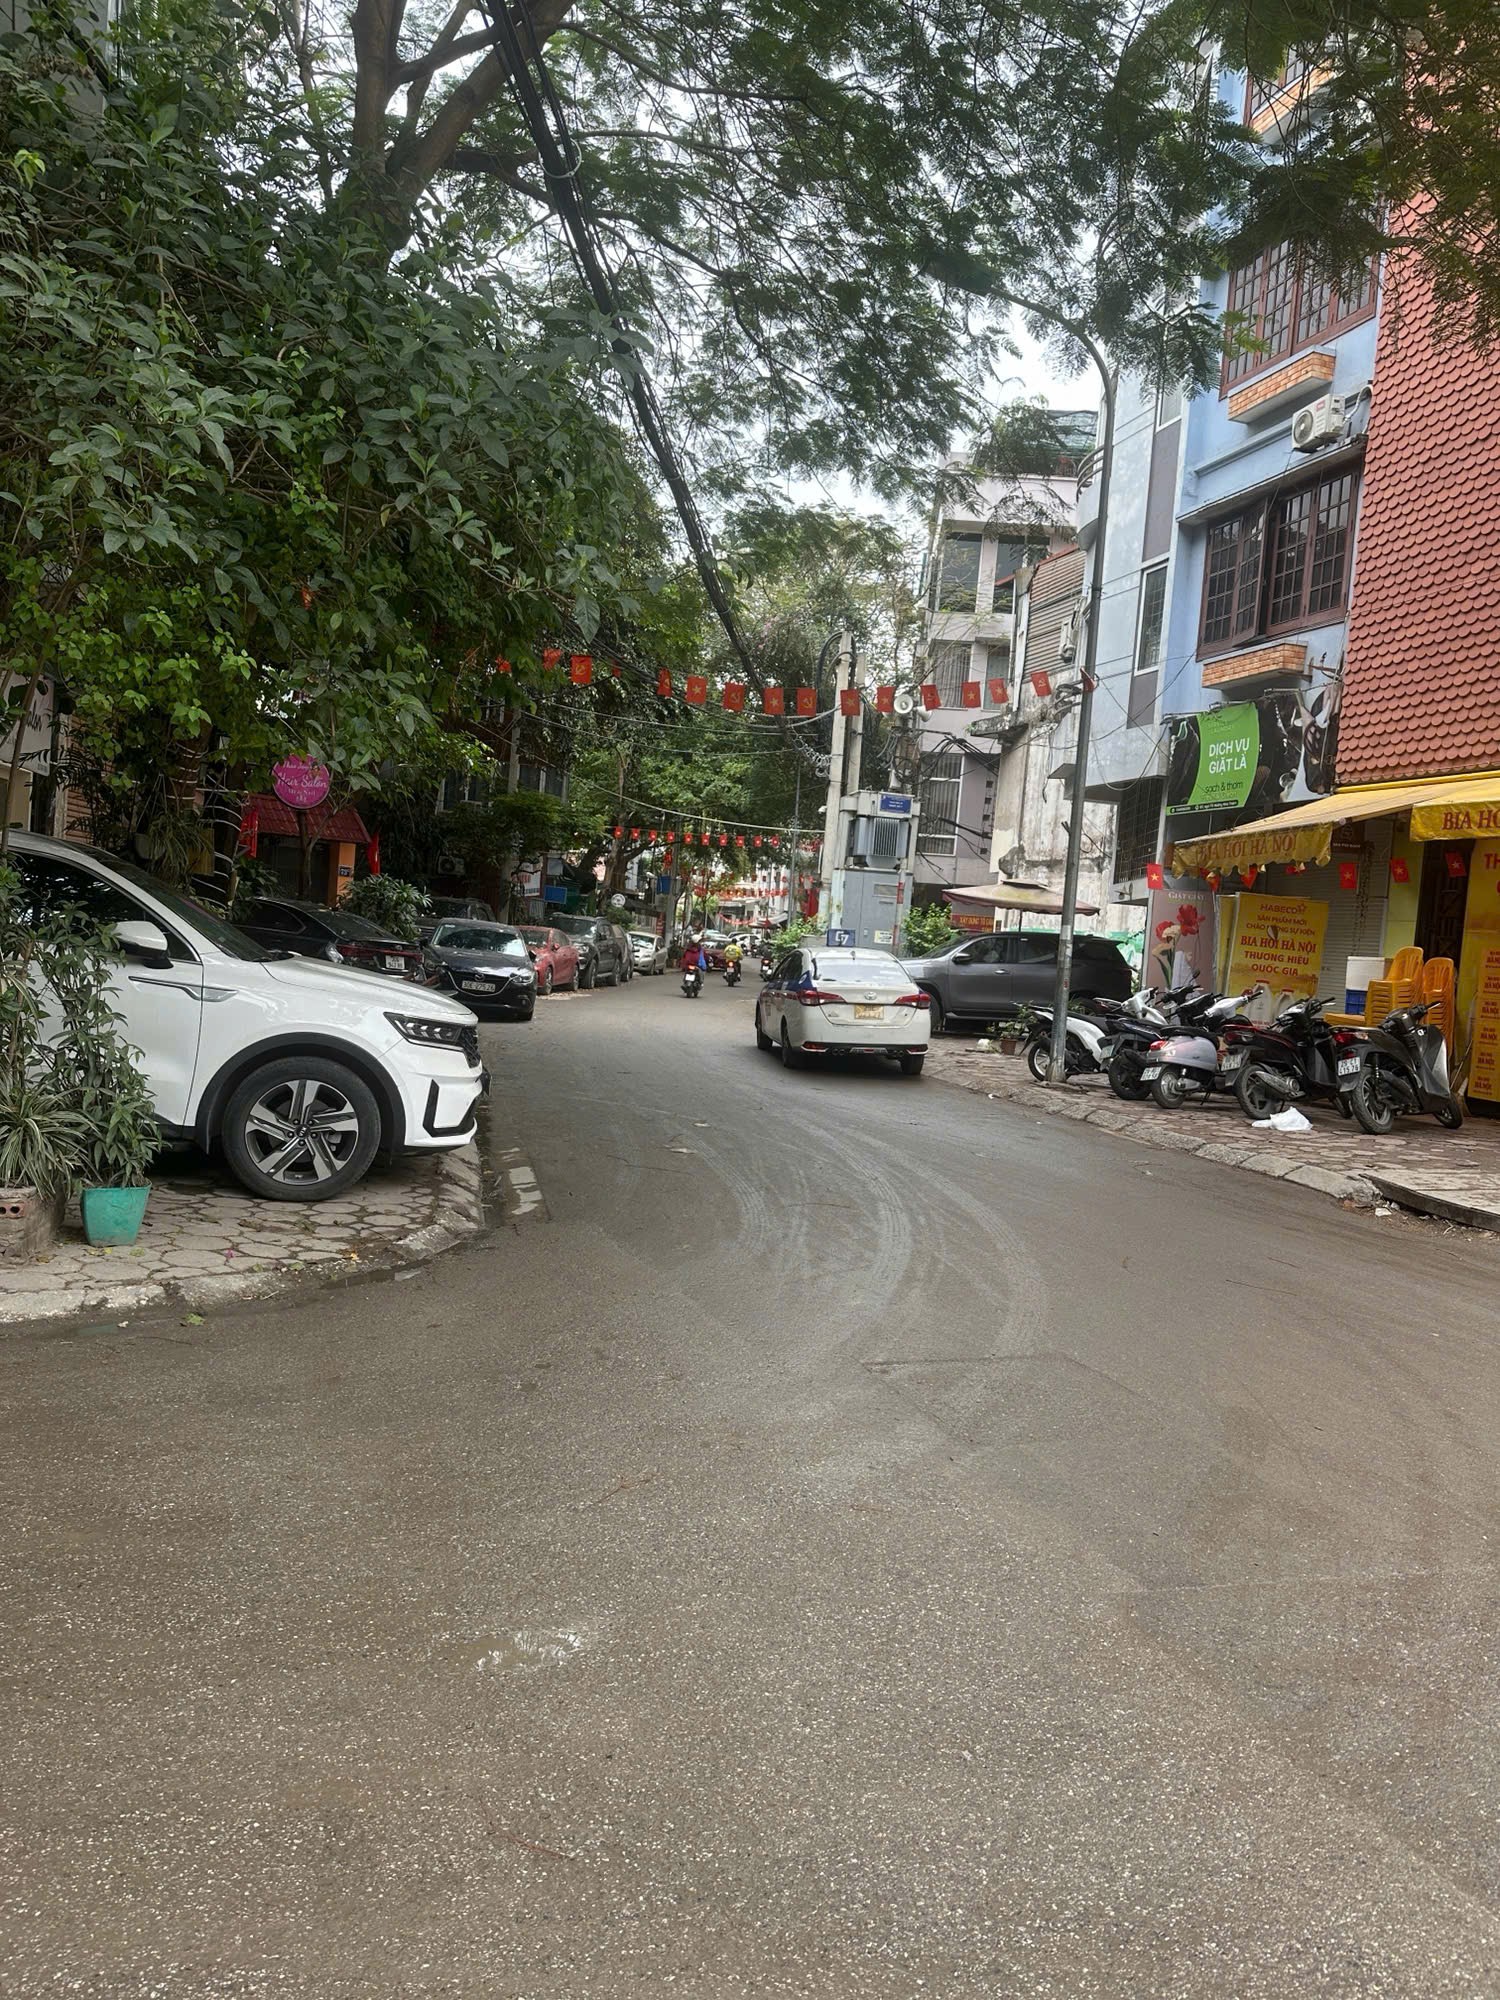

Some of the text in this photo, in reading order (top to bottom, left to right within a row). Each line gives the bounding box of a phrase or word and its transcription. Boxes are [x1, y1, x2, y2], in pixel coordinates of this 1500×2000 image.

[1208, 738, 1250, 759] DỊCH VỤ
[1208, 753, 1247, 776] GIẶT LÀ
[1441, 810, 1472, 830] BIA
[1260, 903, 1297, 914] HABECO
[1240, 935, 1258, 947] BIA
[1282, 966, 1299, 976] GIA
